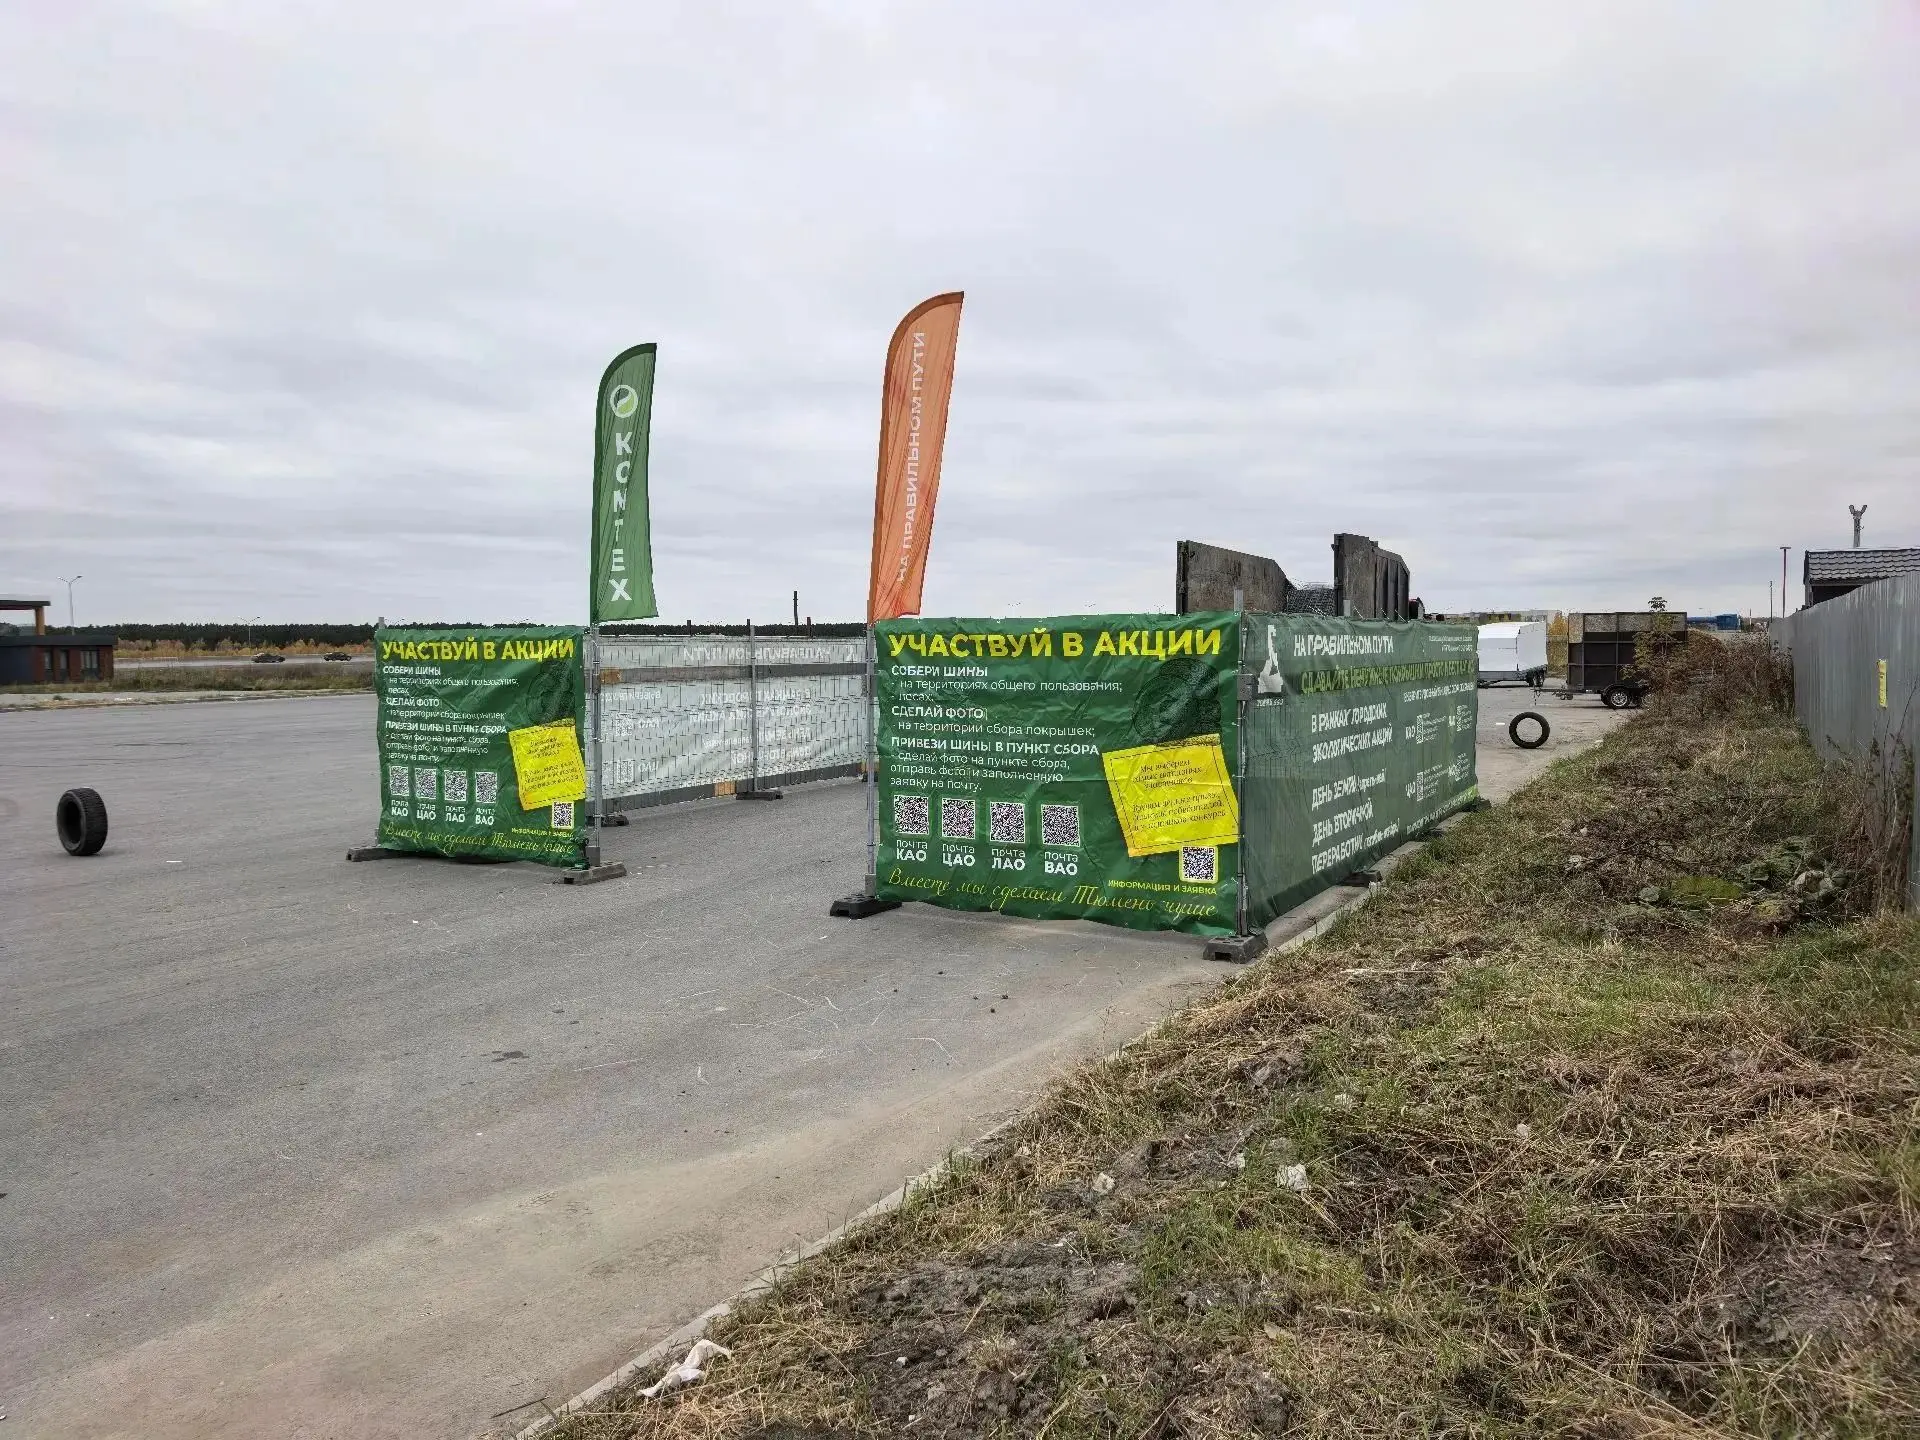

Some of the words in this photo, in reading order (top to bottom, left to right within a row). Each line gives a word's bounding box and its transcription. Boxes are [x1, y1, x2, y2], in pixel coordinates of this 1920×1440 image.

[911, 332, 926, 392] ПУТИ
[902, 396, 922, 550] ПРАВИЛЬНОМ
[382, 637, 479, 660] УЧАСТВУЙ
[483, 642, 496, 660] В
[501, 638, 576, 662] АКЦИИ
[888, 627, 1052, 658] УЧАСТВУЙ
[1062, 632, 1084, 657] В
[1093, 629, 1221, 661] АКЦИИ
[1294, 635, 1305, 657] НА
[1307, 634, 1372, 656] ПРАВИЛЬНОМ
[1373, 636, 1394, 654] ПУТИ
[383, 665, 414, 675] СОБЕРИ
[415, 666, 441, 676] ШИНЫ
[891, 665, 940, 677] СОБЕРИ
[943, 666, 988, 677] ШИНЫ
[900, 680, 913, 689] на
[915, 680, 988, 692] территориях
[990, 680, 1036, 693] общего
[891, 705, 943, 719] СДЕЛАЙ
[1311, 715, 1316, 733] В
[1318, 709, 1349, 731] РАМКАХ
[420, 723, 444, 732] ШИНЫ
[445, 724, 452, 733] В
[452, 725, 479, 733] ПУНКТ
[480, 725, 508, 734] СБОРА
[898, 722, 912, 731] на
[914, 722, 983, 735] территории
[986, 723, 1023, 736] сбора
[1371, 723, 1394, 748] АКЦИЙ
[891, 737, 947, 750] ПРИВЕЗИ
[950, 739, 992, 752] ШИНЫ
[995, 741, 1004, 752] В
[1006, 742, 1051, 755] ПУНКТ
[1053, 743, 1100, 756] СБОРА
[898, 751, 938, 763] сделай
[940, 752, 968, 767] фото
[971, 756, 984, 766] на
[987, 758, 1028, 771] пункте
[1031, 756, 1070, 771] сбора,
[890, 763, 937, 776] отправь
[972, 767, 981, 777] и
[982, 769, 1063, 784] заполненную
[890, 777, 928, 789] заявку
[931, 780, 944, 789] на
[1312, 784, 1333, 812] ДЕНЬ
[1333, 774, 1357, 800] ЗЕМЛИ
[391, 806, 409, 817] КАО
[416, 808, 437, 822] ЦАО
[445, 812, 466, 823] ЛАО
[475, 814, 495, 826] ВАО
[1312, 819, 1333, 848] ДЕНЬ
[1333, 797, 1374, 834] ВТОРИЧНОЙ
[896, 839, 928, 850] почта
[942, 843, 975, 855] почта
[896, 848, 927, 862] КАО
[942, 853, 976, 868] ЦАО
[991, 848, 1026, 859] почта
[1044, 851, 1079, 863] почта
[991, 857, 1026, 871] ЛАО
[1044, 861, 1078, 876] ВАО
[888, 867, 950, 897] Вместе
[956, 880, 988, 895] мы
[989, 885, 1064, 911] сделаем
[1071, 884, 1155, 911] Тюмень
[1108, 879, 1171, 892] ИНФОРМАЦИЯ
[1173, 884, 1180, 892] И
[1181, 885, 1217, 895] ЗАЯВКА
